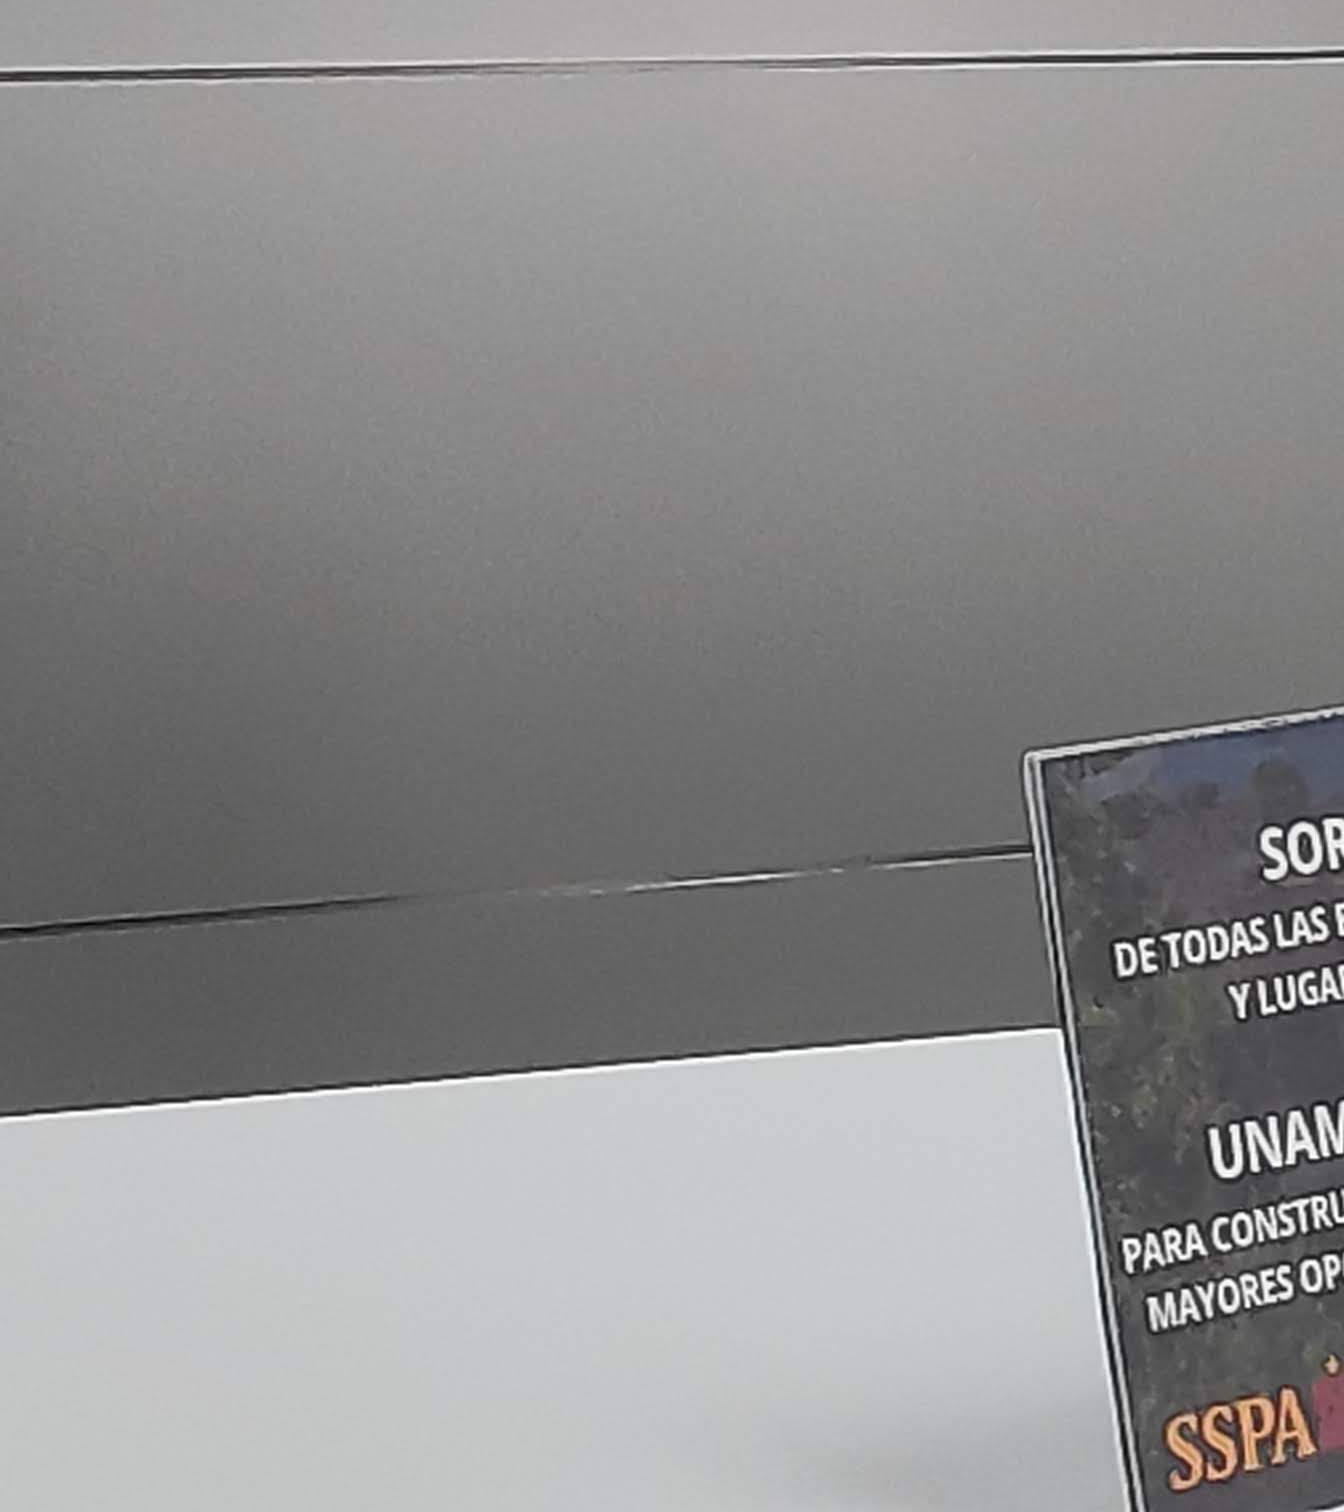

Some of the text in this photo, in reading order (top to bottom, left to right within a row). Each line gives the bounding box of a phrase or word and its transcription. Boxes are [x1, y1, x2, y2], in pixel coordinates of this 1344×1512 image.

[1114, 938, 1159, 978] DE
[1161, 917, 1269, 968] TODAS
[1274, 906, 1330, 948] LAS
[1227, 983, 1250, 1020] Y
[1121, 1223, 1208, 1275] PARA
[1146, 1264, 1294, 1333] MAYORES
[1163, 1386, 1319, 1493] SSPA
